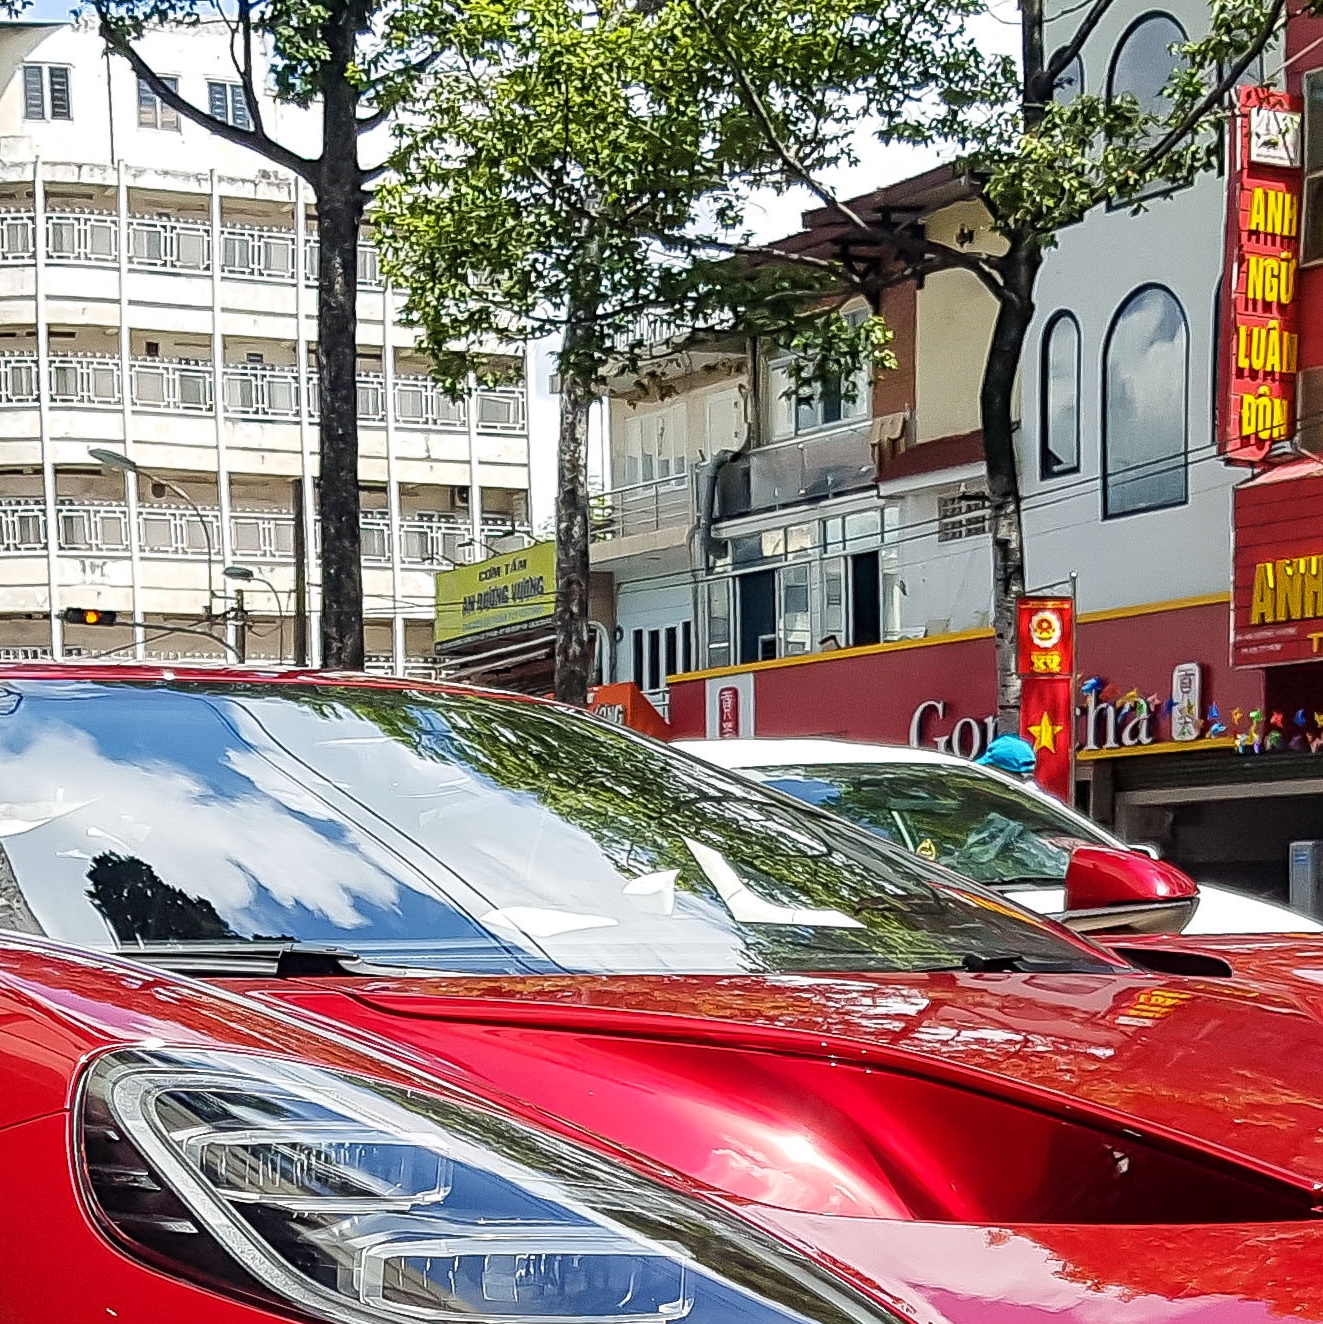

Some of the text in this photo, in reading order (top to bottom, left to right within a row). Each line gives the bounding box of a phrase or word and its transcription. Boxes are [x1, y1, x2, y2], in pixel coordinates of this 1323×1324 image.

[1249, 187, 1298, 236] ANH
[1247, 251, 1297, 304] NGỮ
[1238, 320, 1297, 373] LUÂN
[1241, 386, 1287, 441] ĐÔN
[1076, 689, 1153, 749] ha
